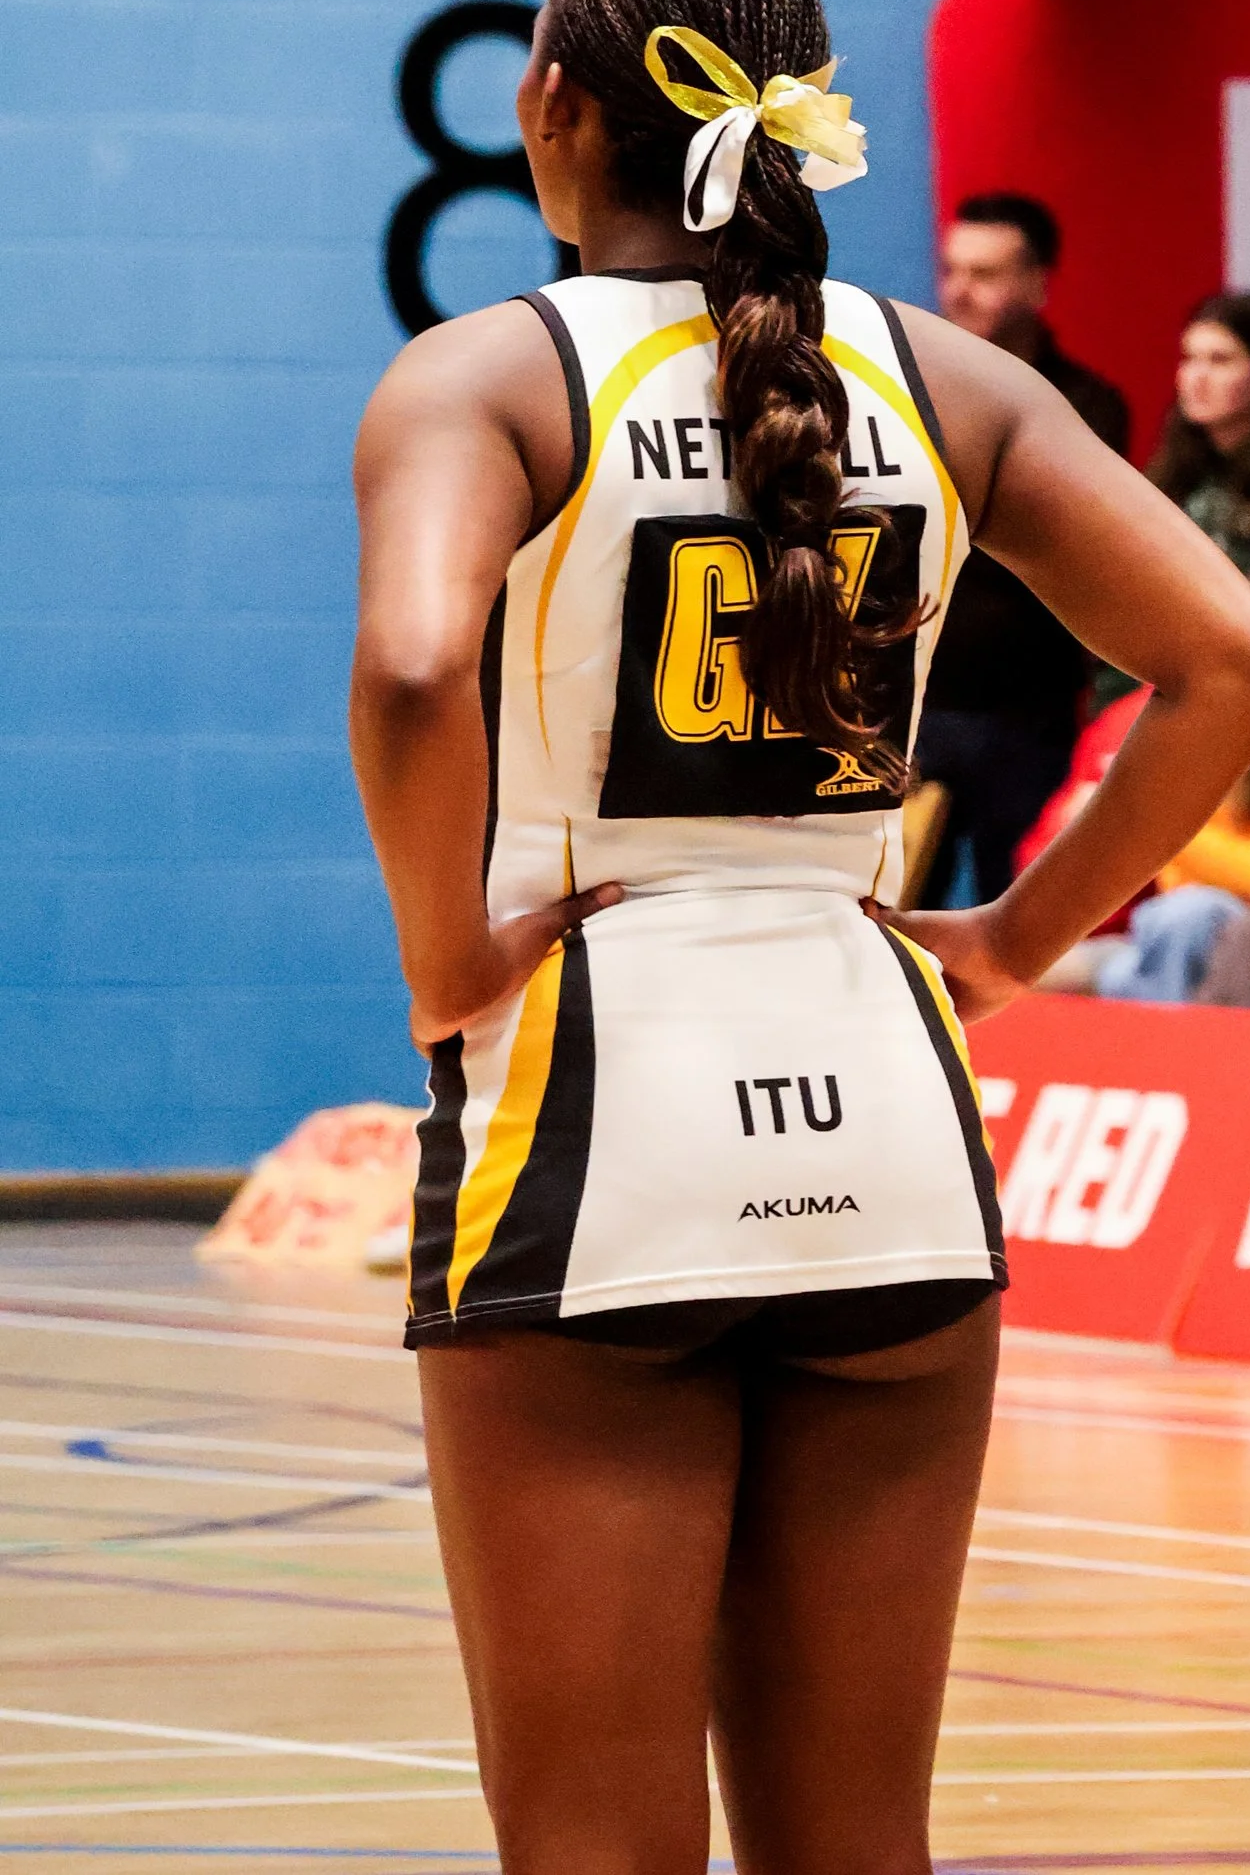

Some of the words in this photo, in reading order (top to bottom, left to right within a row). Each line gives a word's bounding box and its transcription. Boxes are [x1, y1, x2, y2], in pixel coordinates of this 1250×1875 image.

[626, 416, 902, 480] NETLL
[815, 780, 884, 797] GILBERT
[734, 1074, 843, 1136] ITU
[1001, 1082, 1190, 1250] RED
[737, 1194, 861, 1223] AKUMA
